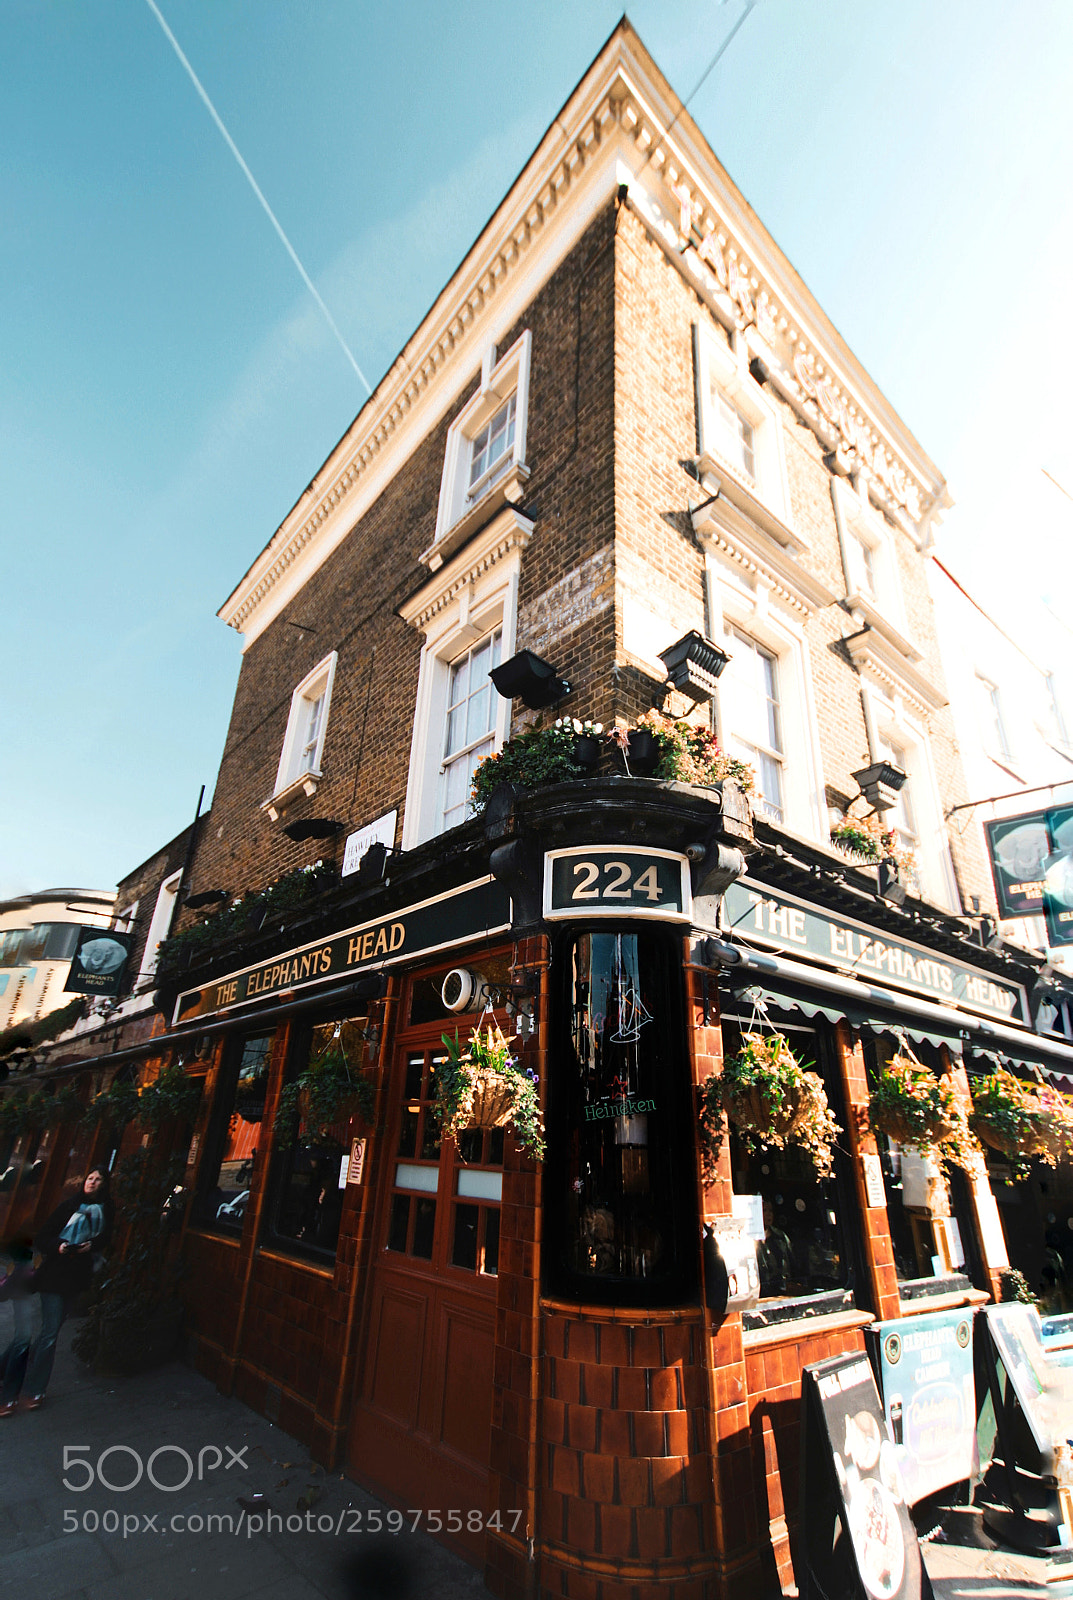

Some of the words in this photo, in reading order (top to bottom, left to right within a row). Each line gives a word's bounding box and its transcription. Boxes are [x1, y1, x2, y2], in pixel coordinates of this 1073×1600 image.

[571, 861, 663, 901] 224
[216, 980, 239, 1006] THE
[246, 946, 332, 997] ELEPHANTS
[346, 922, 406, 965] HEAD
[748, 893, 807, 945] THE
[829, 922, 953, 992] ELEPHANTS
[964, 973, 1011, 1012] HEAD
[8, 974, 28, 1016] University
[36, 967, 55, 1008] University
[77, 972, 115, 982] ELEPHANTS
[583, 1099, 657, 1121] Heineken
